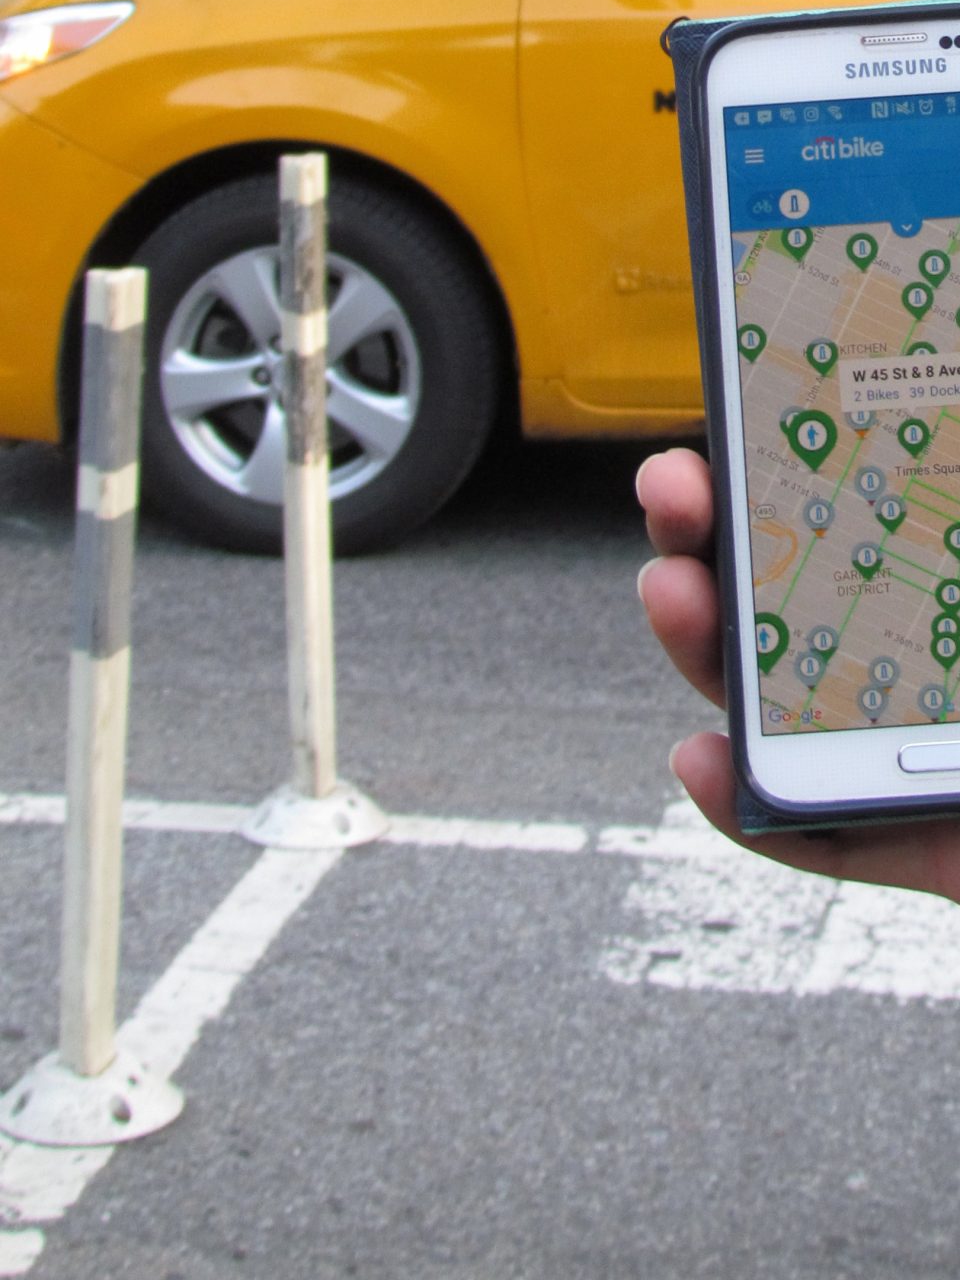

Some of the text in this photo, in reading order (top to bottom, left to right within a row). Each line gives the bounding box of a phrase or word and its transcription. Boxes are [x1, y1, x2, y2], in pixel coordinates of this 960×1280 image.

[845, 57, 948, 80] SAMSUNG
[801, 137, 884, 162] citi bike
[839, 342, 888, 355] KITCHEN
[852, 370, 867, 383] W
[870, 369, 889, 382] 45
[892, 368, 908, 380] St
[911, 368, 922, 379] &
[925, 365, 935, 378] 8
[853, 390, 861, 402] 2
[867, 388, 900, 401] Bikes
[909, 387, 925, 399] 39
[895, 466, 930, 477] Times
[837, 582, 892, 597] DISTRICT
